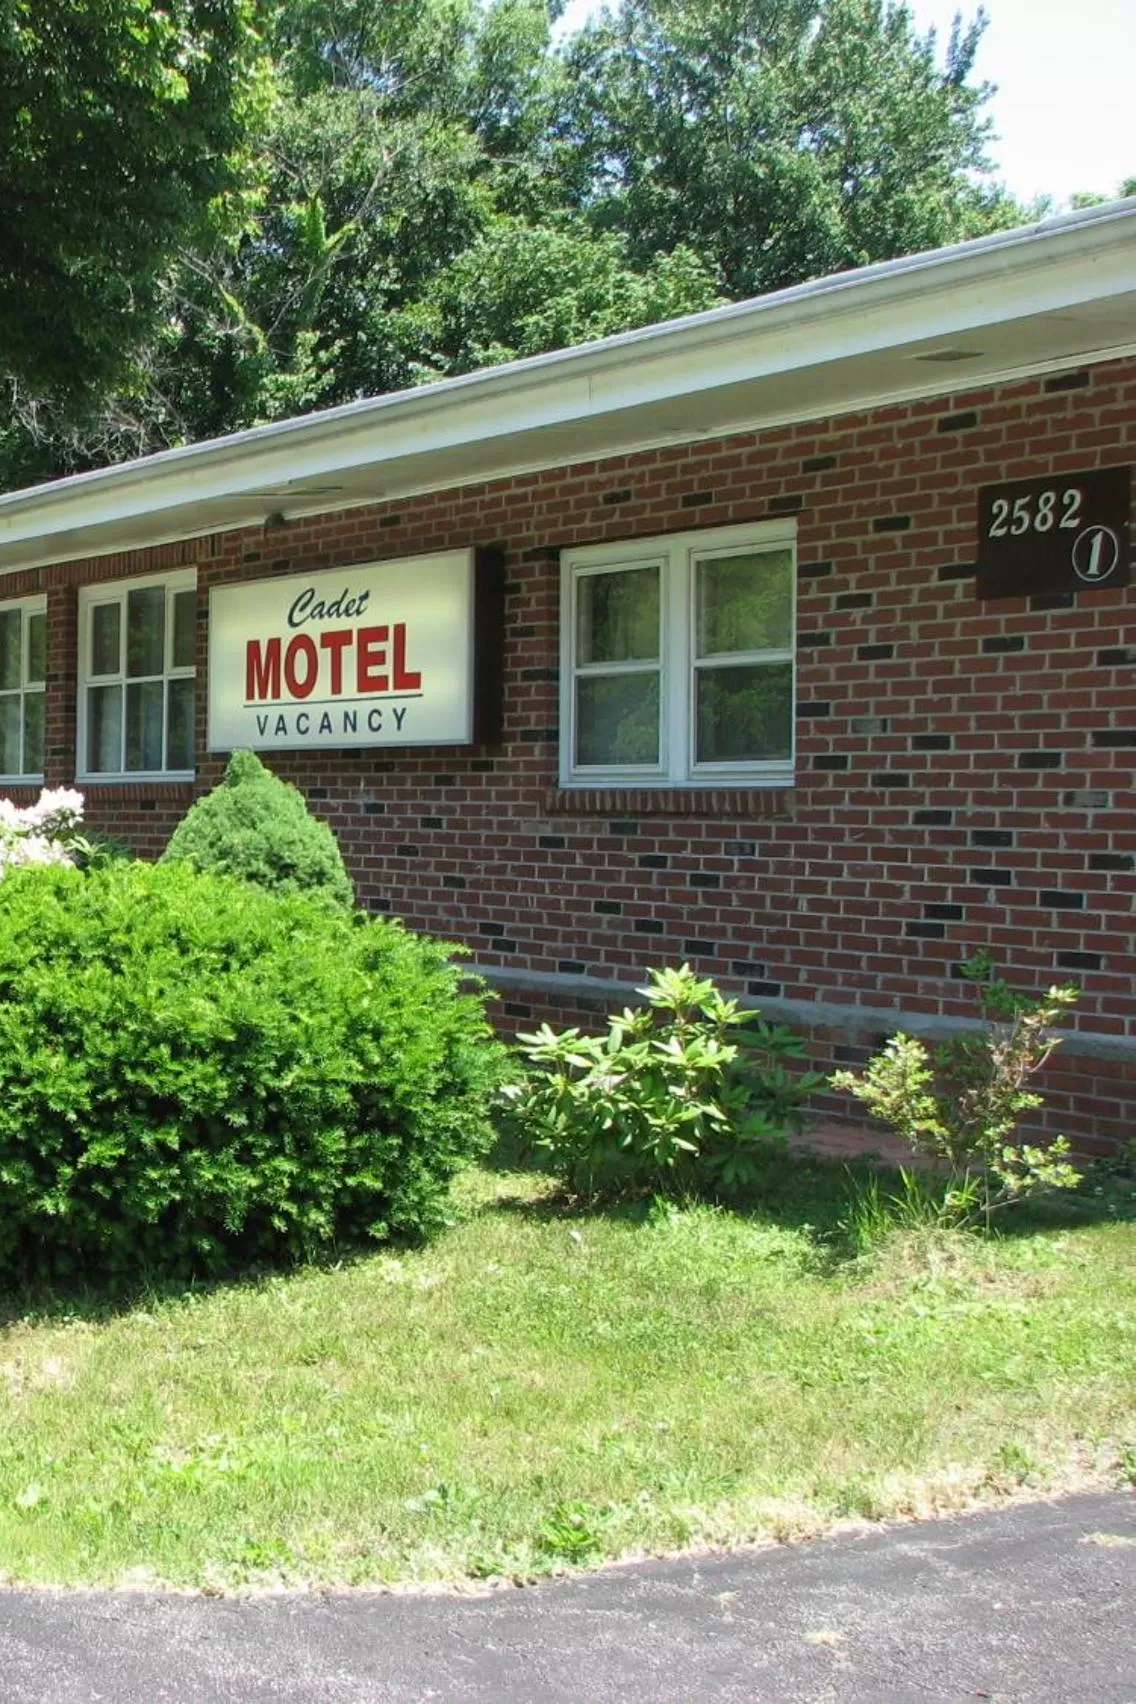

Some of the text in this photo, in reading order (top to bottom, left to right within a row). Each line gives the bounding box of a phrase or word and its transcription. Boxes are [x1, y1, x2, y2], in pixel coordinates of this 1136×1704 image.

[988, 488, 1082, 538] 2582
[287, 587, 370, 628] Cadet
[245, 622, 422, 701] MOTEL
[256, 707, 407, 736] VACANCY
